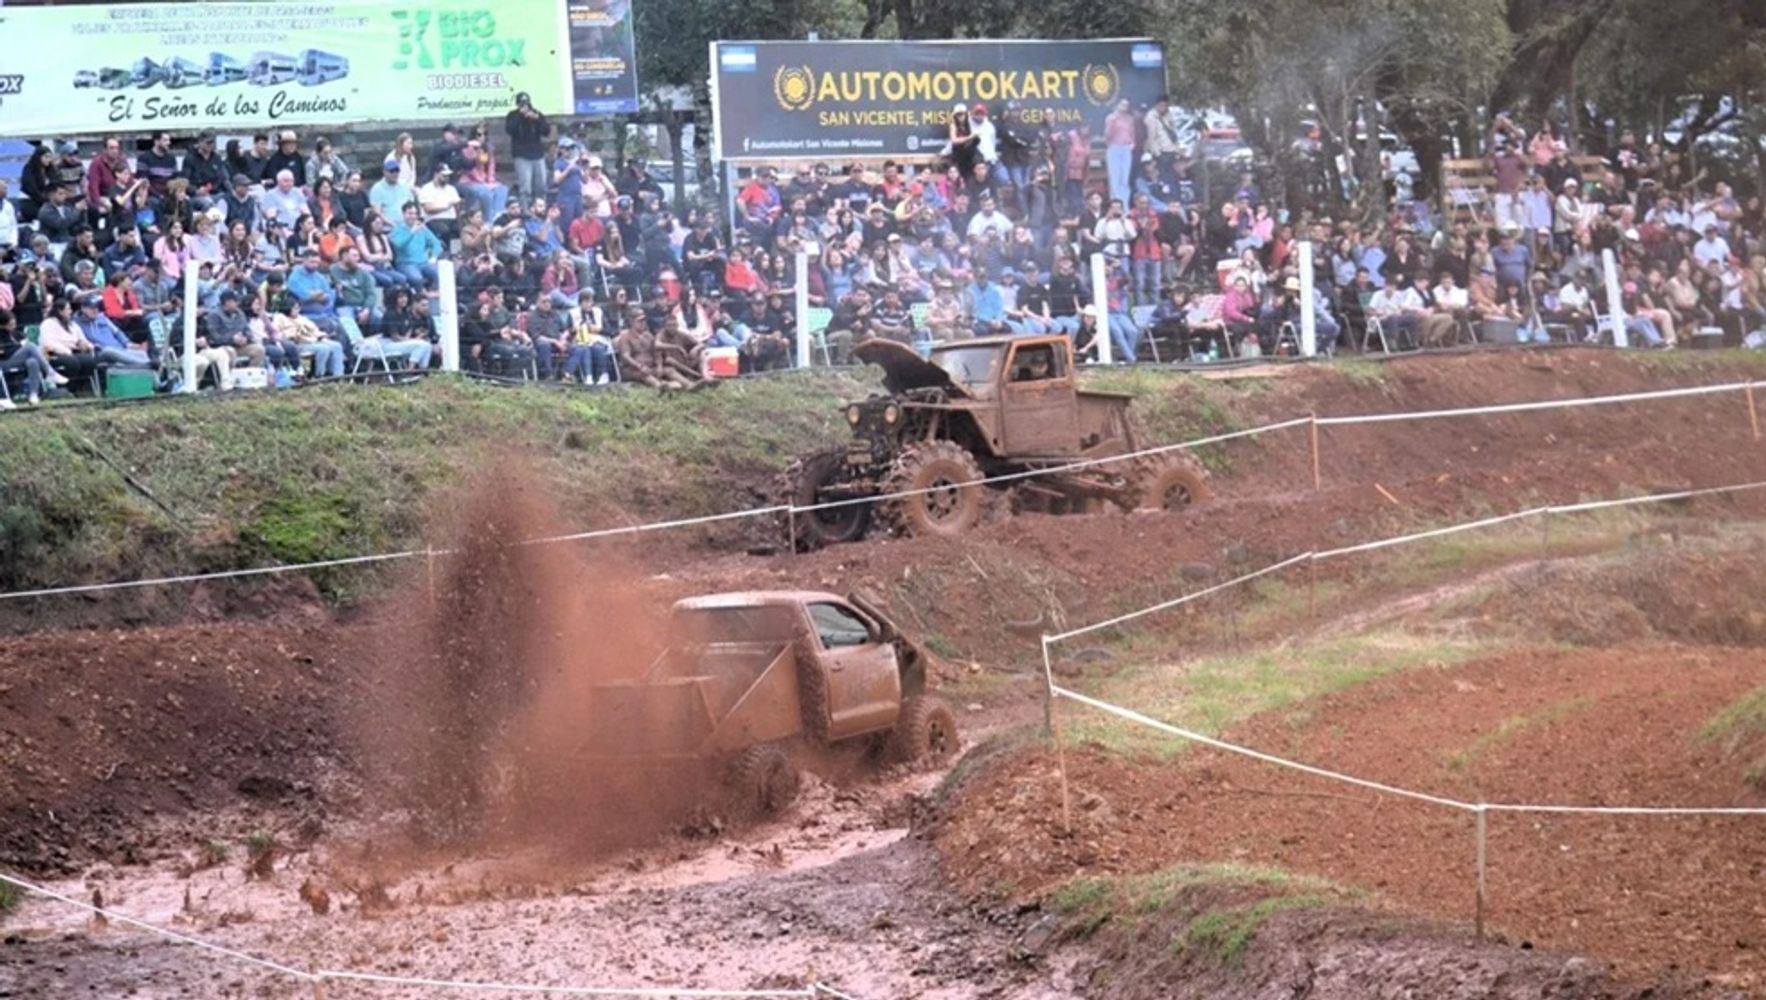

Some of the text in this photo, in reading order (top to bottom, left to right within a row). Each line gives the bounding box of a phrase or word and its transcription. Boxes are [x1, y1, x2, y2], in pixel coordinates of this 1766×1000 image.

[438, 9, 496, 39] BIO
[440, 38, 526, 68] PROX
[426, 71, 508, 90] BIODIESEL
[819, 71, 1079, 101] AUTOMOTOKART
[142, 96, 198, 120] Señor
[205, 96, 227, 116] de
[234, 93, 260, 115] los
[819, 111, 850, 126] SAN
[853, 111, 919, 126] VICENTE,
[751, 139, 804, 150] Automotokart
[806, 139, 821, 148] San
[823, 138, 850, 149] Vicente
[851, 138, 884, 148] Misiones
